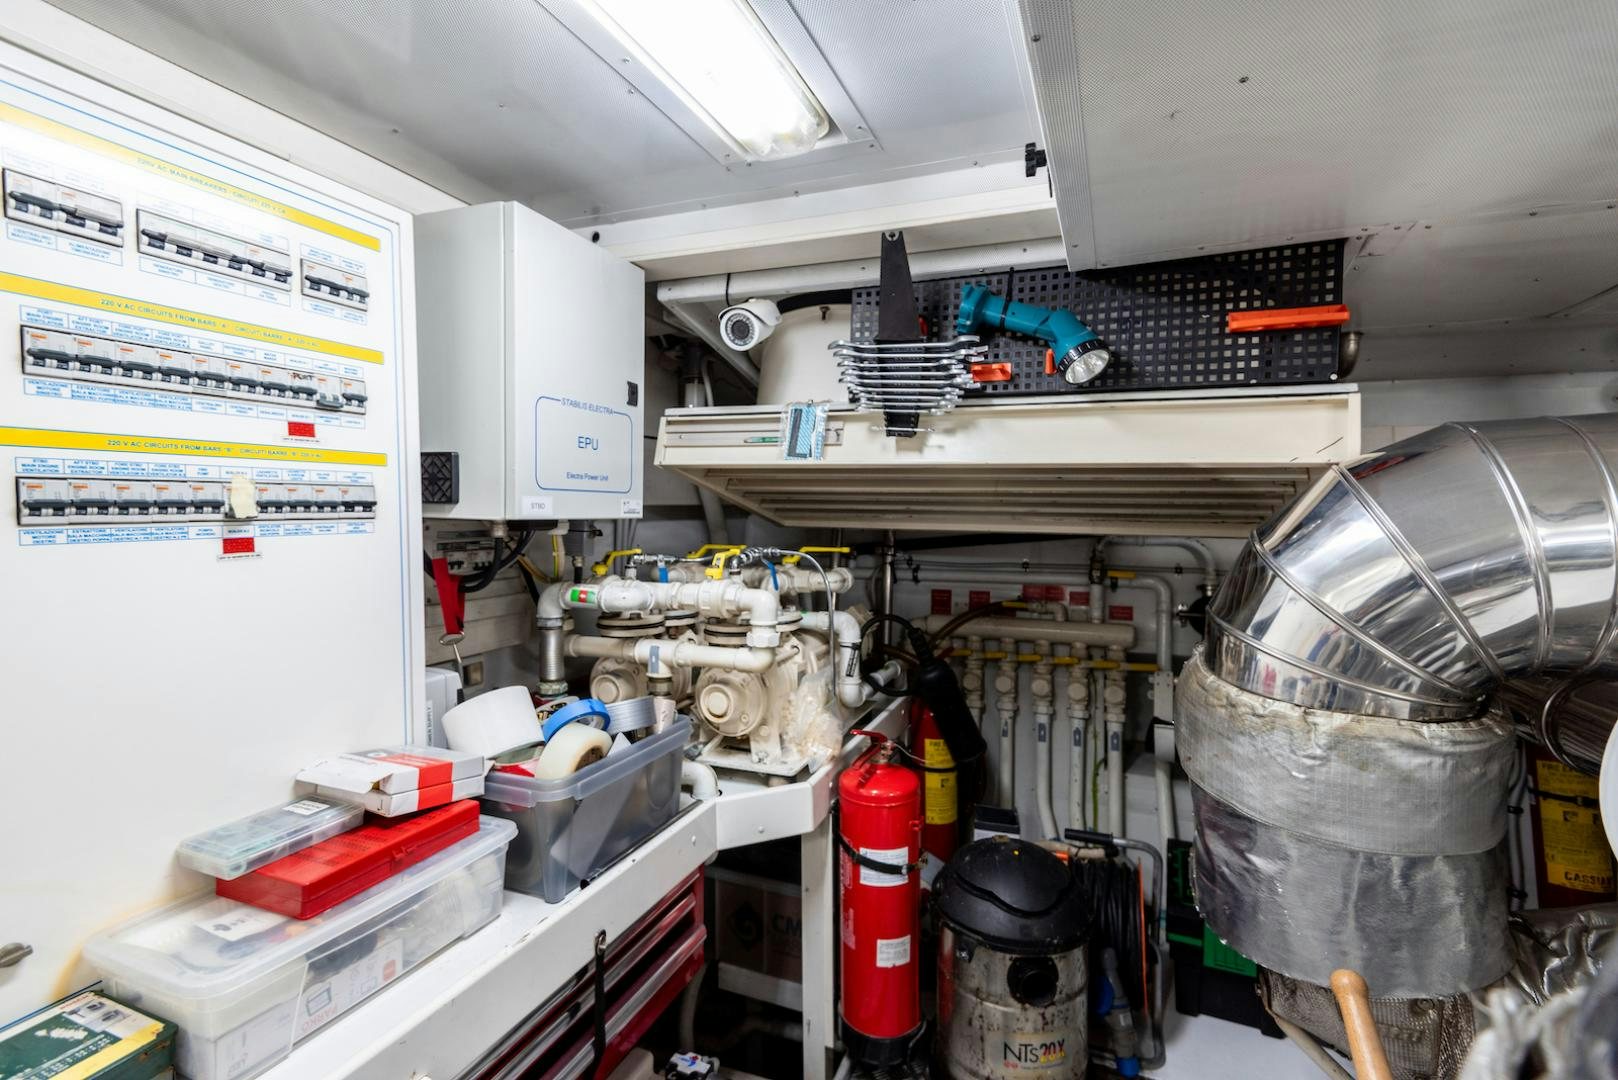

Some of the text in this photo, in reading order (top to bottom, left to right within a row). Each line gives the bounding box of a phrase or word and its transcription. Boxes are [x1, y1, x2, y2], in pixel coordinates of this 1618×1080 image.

[138, 306, 174, 318] CIRCUITS
[175, 313, 196, 322] FROM
[561, 397, 614, 416] STABILIS ELECTRA
[144, 442, 179, 450] CIRCUITS
[577, 435, 599, 451] EPU
[584, 472, 599, 481] Power
[599, 474, 609, 482] Unit
